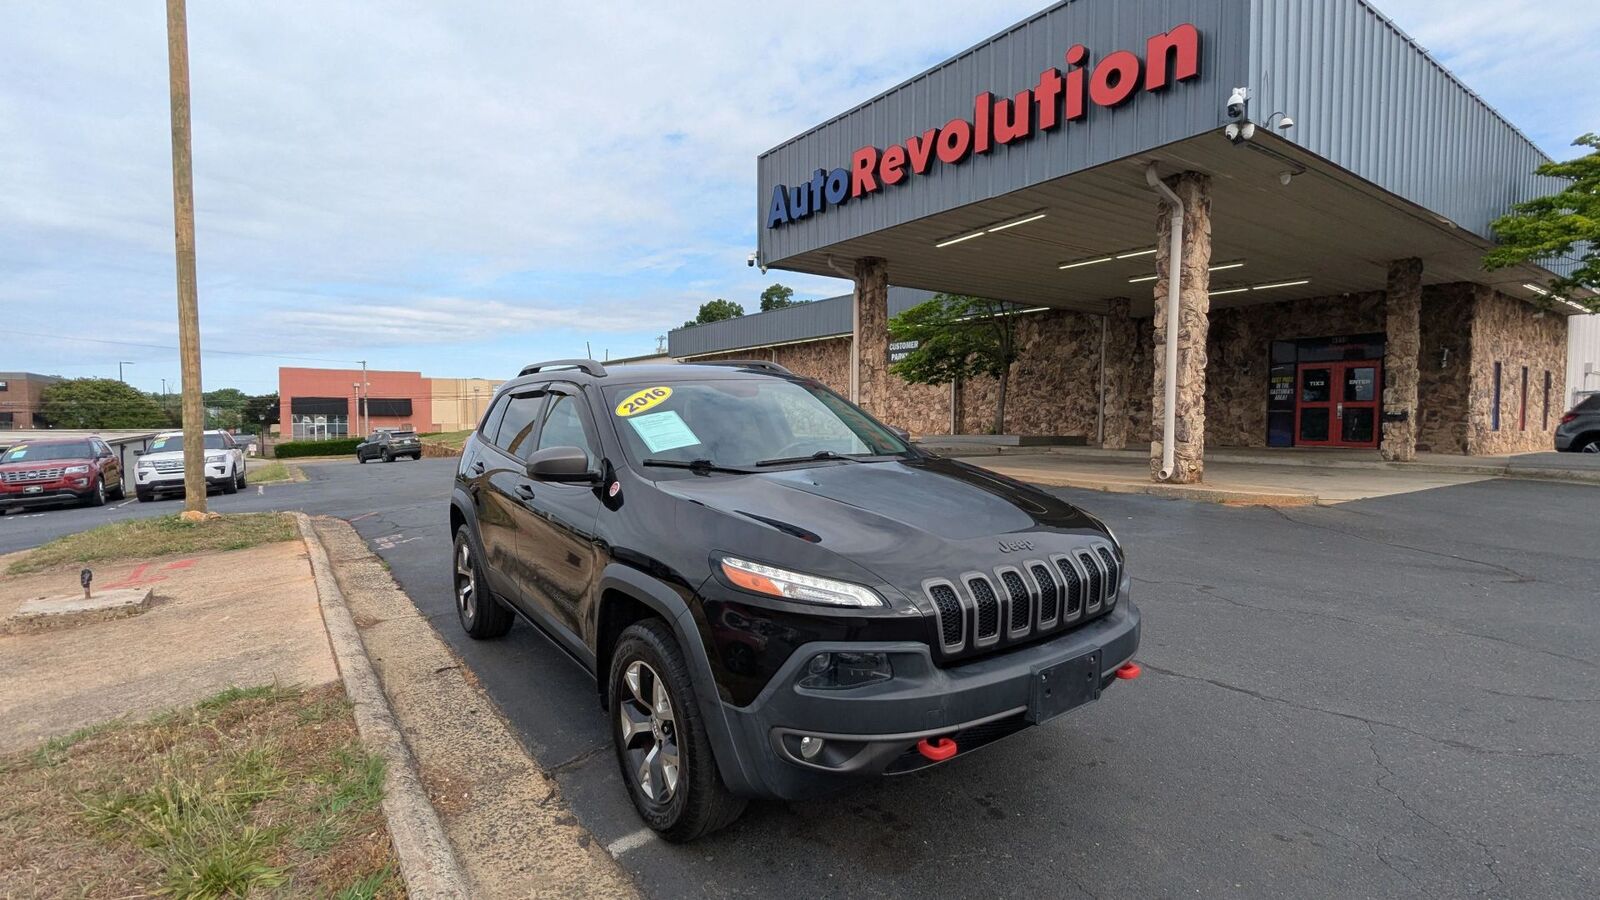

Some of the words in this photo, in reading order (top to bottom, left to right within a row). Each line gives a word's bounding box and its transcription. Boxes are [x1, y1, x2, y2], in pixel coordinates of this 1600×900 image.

[767, 22, 1201, 229] AutoRevolution
[889, 341, 918, 350] CUSTOMER
[623, 388, 666, 414] 2016
[999, 539, 1035, 553] Jeep
